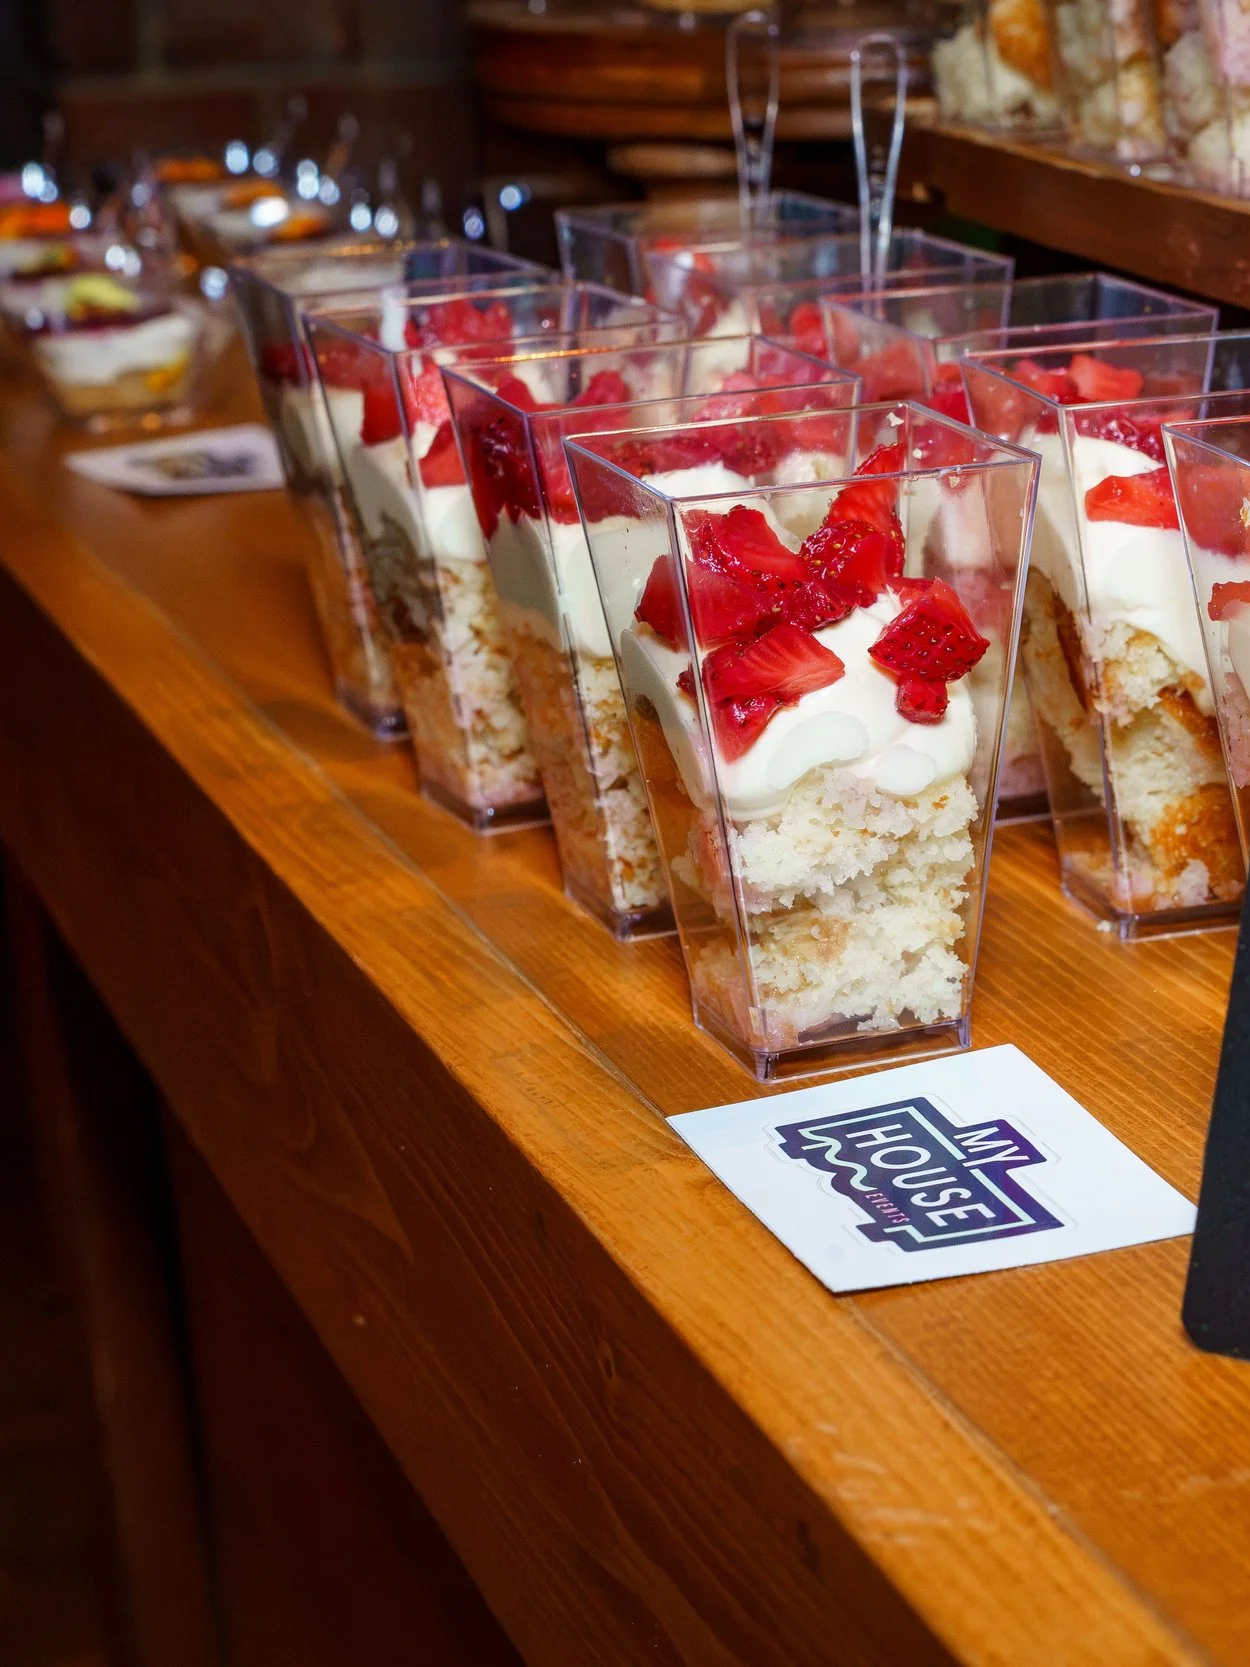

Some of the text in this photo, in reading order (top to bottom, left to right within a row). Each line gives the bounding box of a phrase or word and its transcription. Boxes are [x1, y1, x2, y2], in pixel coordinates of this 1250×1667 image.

[953, 1126, 1030, 1168] MY
[845, 1123, 997, 1228] HOUSE
[865, 1192, 911, 1224] EVENTS
